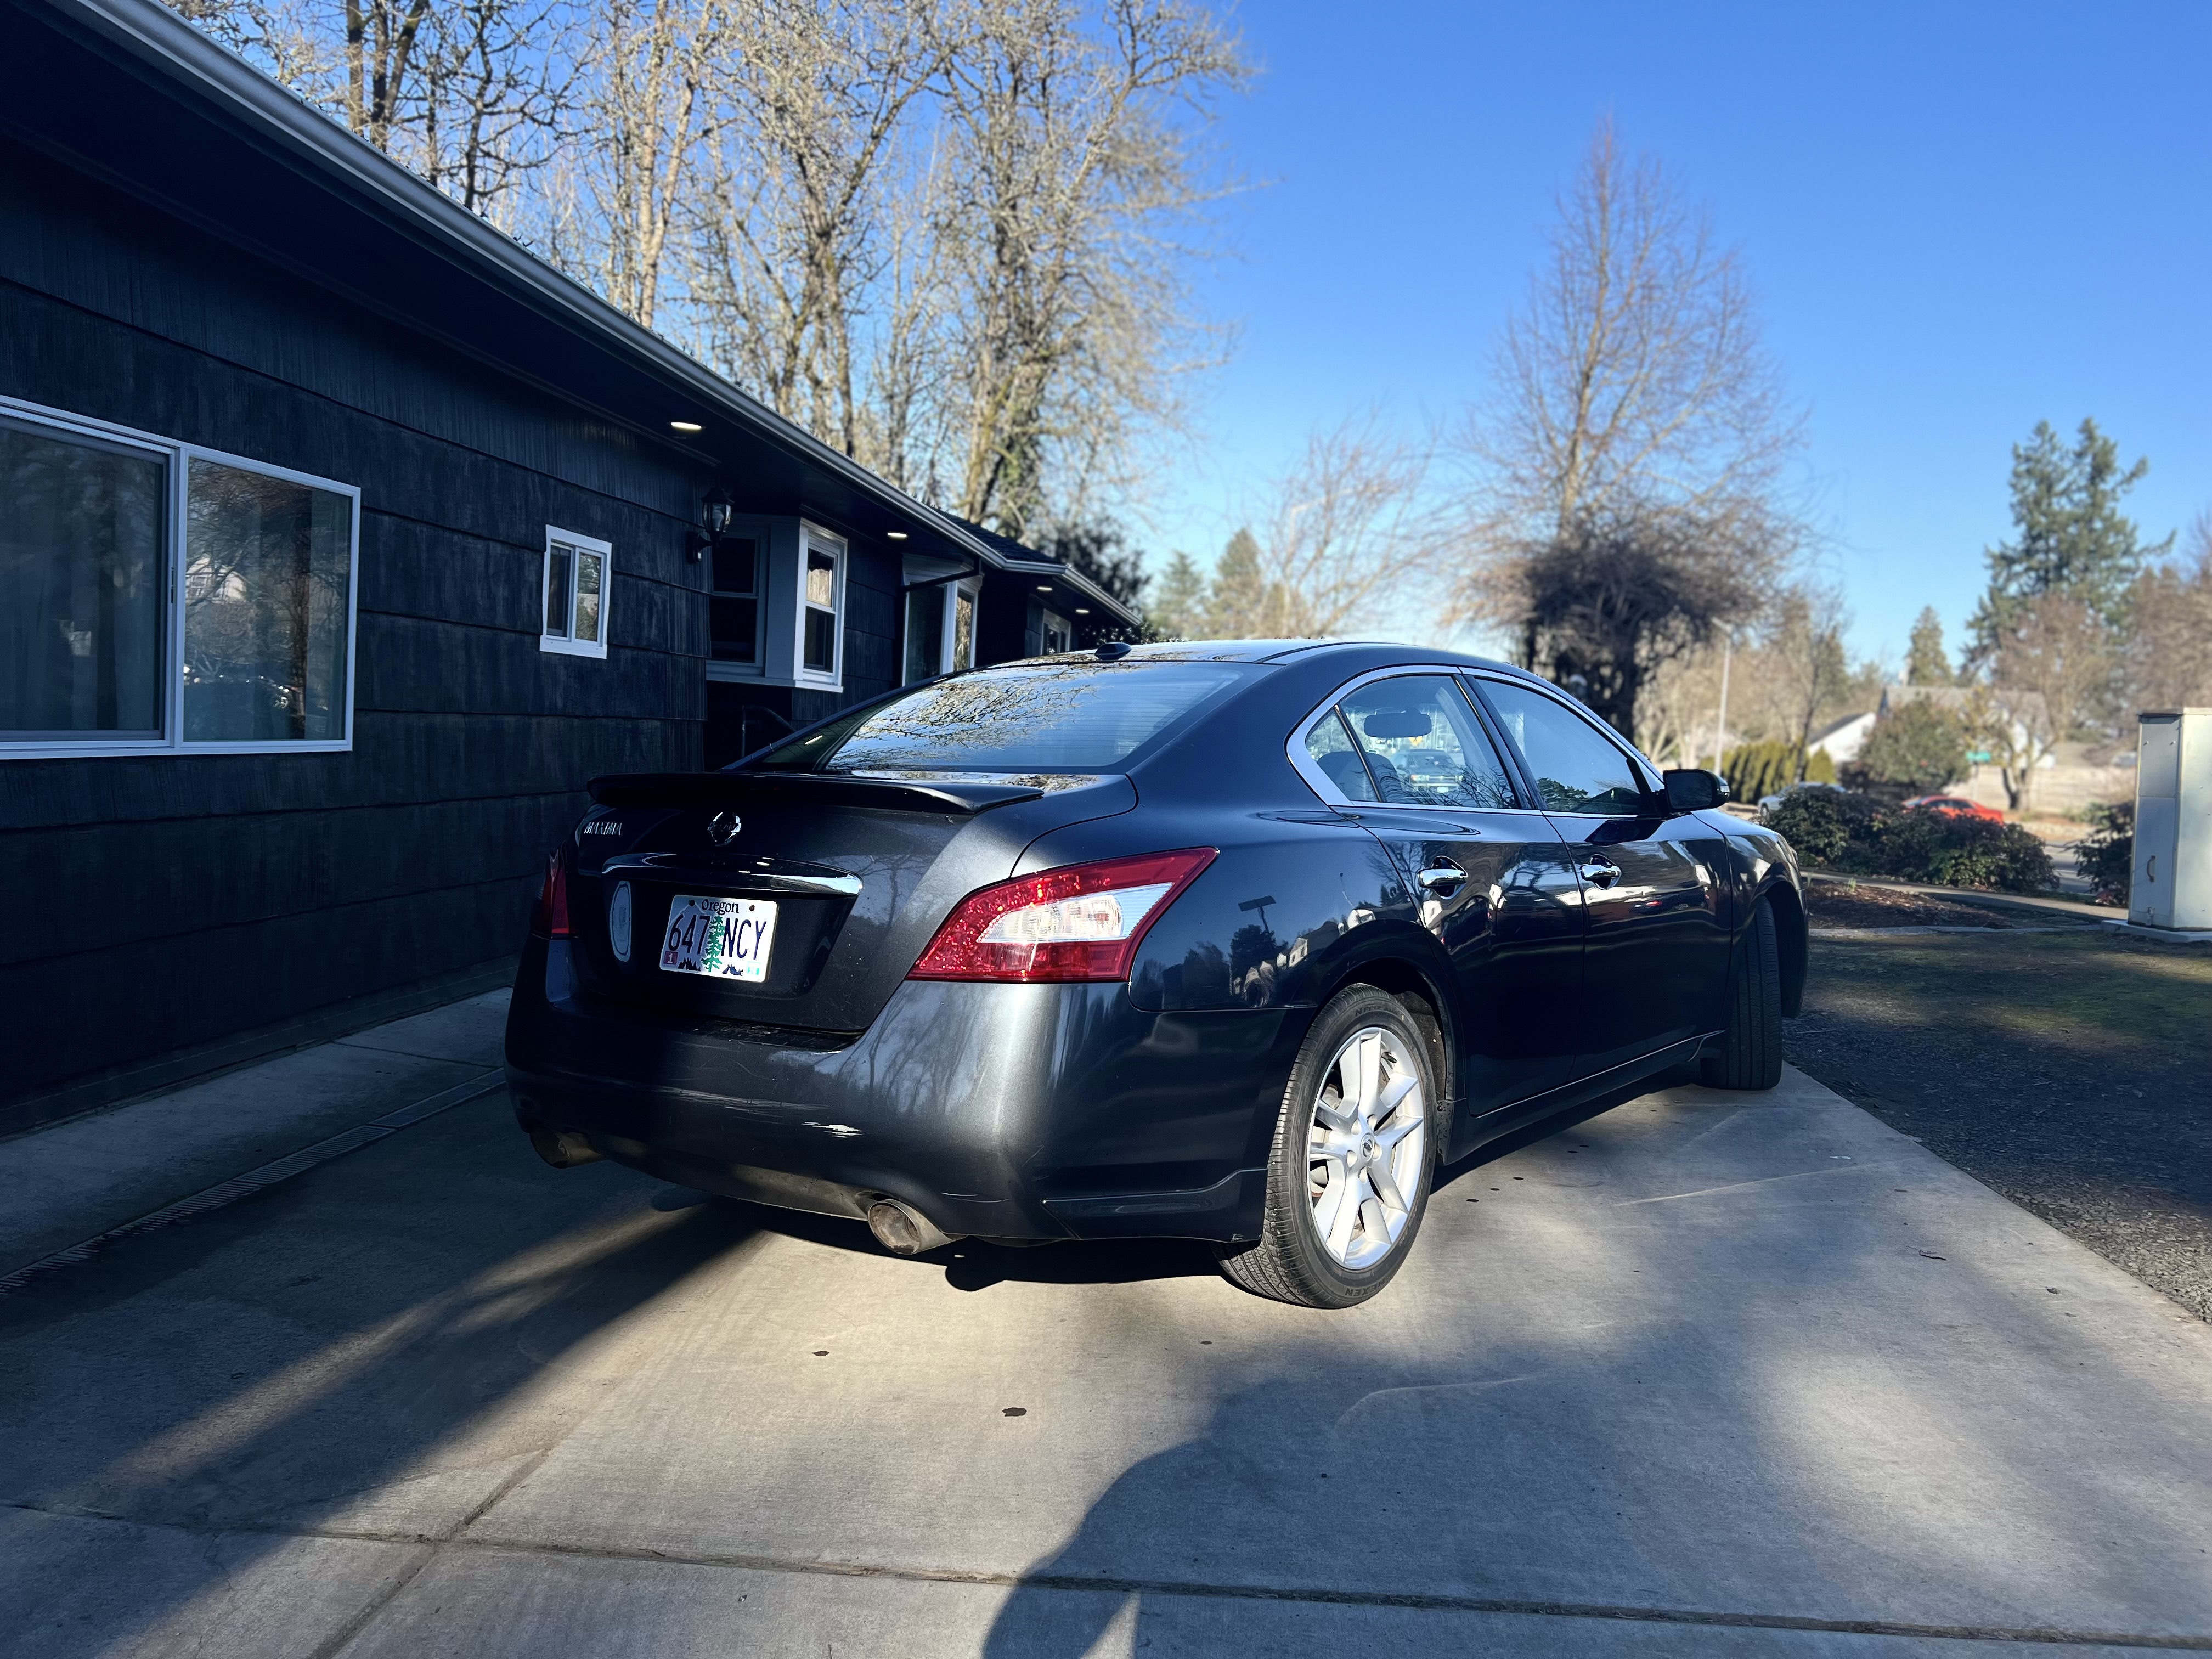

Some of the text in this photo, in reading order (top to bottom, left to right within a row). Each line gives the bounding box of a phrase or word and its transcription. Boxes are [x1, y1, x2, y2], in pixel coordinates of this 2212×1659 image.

[584, 822, 622, 835] MAXIMA
[701, 899, 740, 916] Oregon
[668, 913, 767, 961] 647 NCY
[667, 953, 673, 964] 1
[1344, 1277, 1386, 1297] NEXEN
